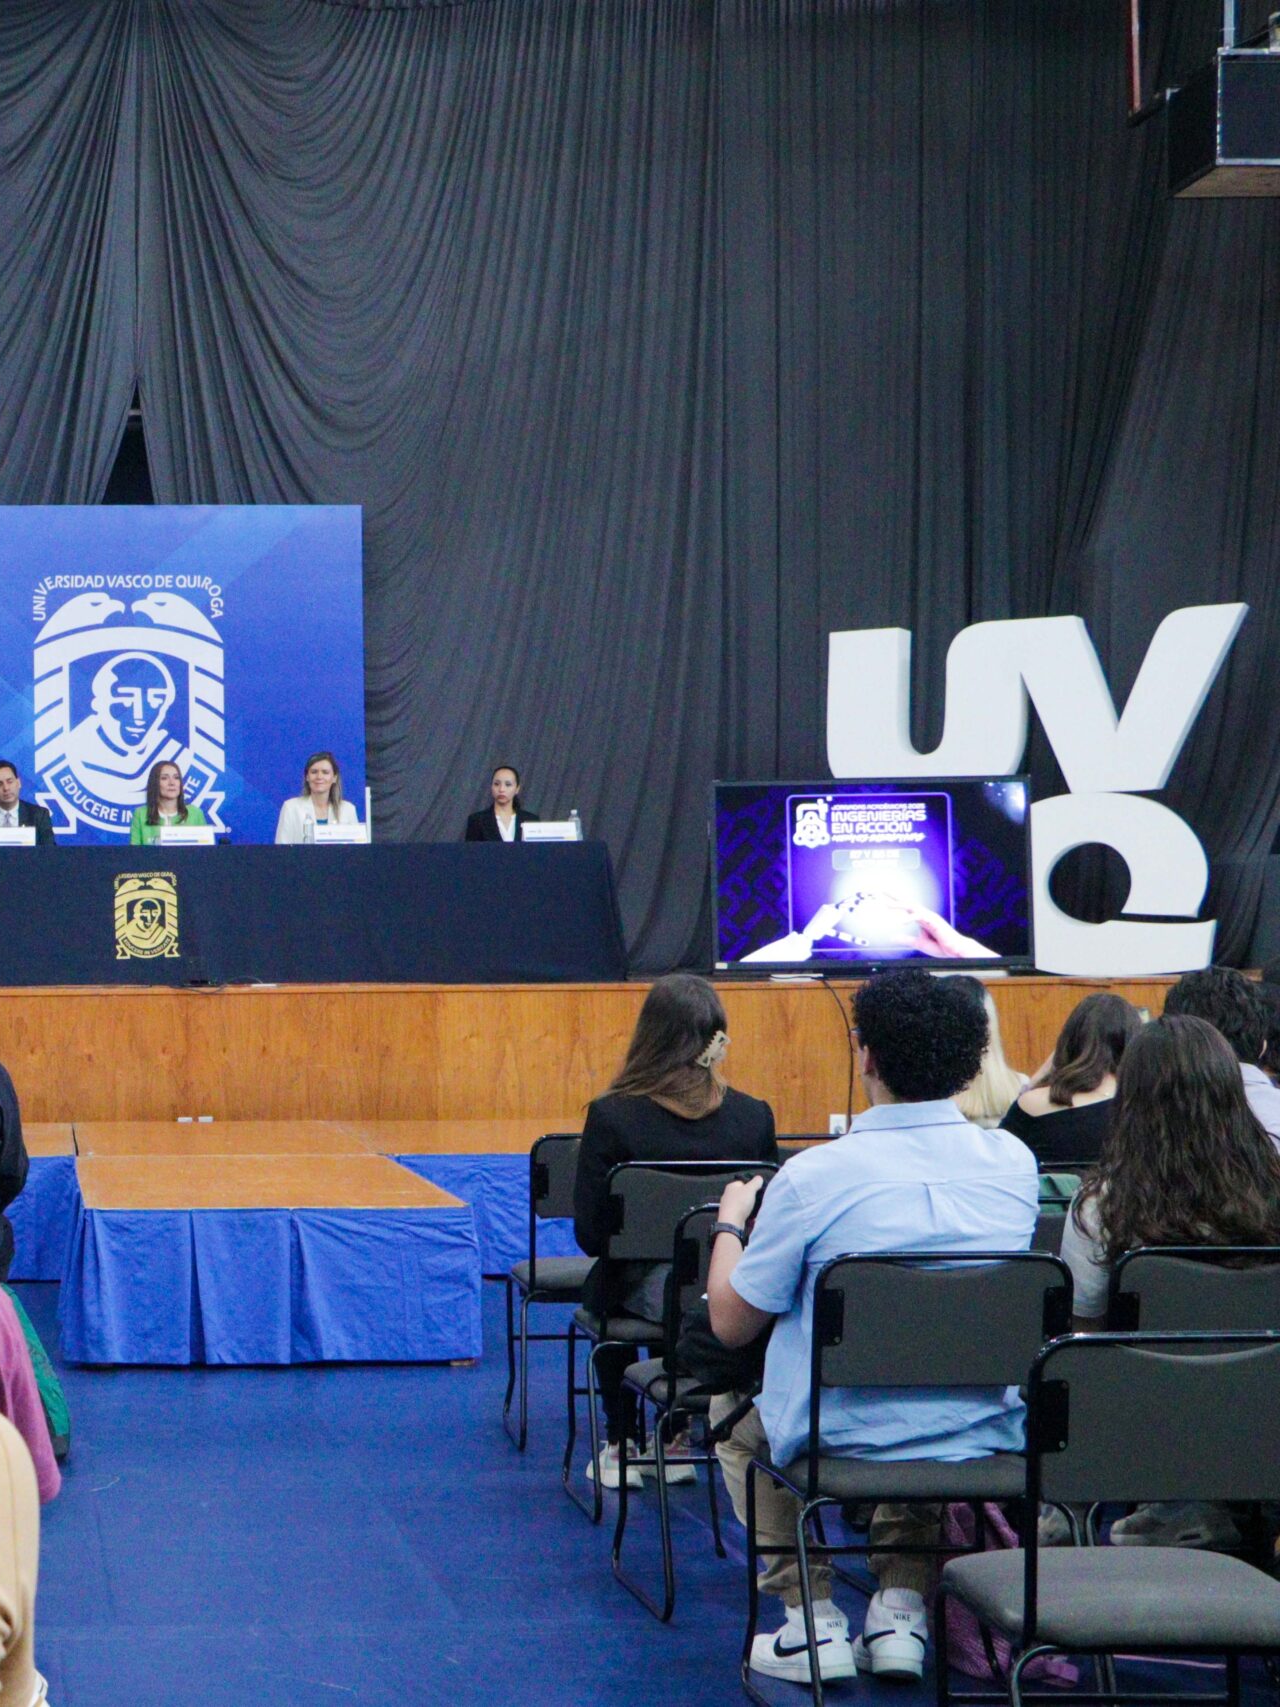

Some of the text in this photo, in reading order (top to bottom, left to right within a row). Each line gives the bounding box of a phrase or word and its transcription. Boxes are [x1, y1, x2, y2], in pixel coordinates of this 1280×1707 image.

[33, 574, 224, 621] UNIVERSIDAD VASCO DE QUIROGA
[59, 774, 119, 823] EDUCERE
[831, 809, 926, 822] INGENIERÍAS
[831, 820, 912, 834] EN ACCIÓN
[893, 1612, 912, 1622] NIKE
[826, 1619, 844, 1629] NIKE
